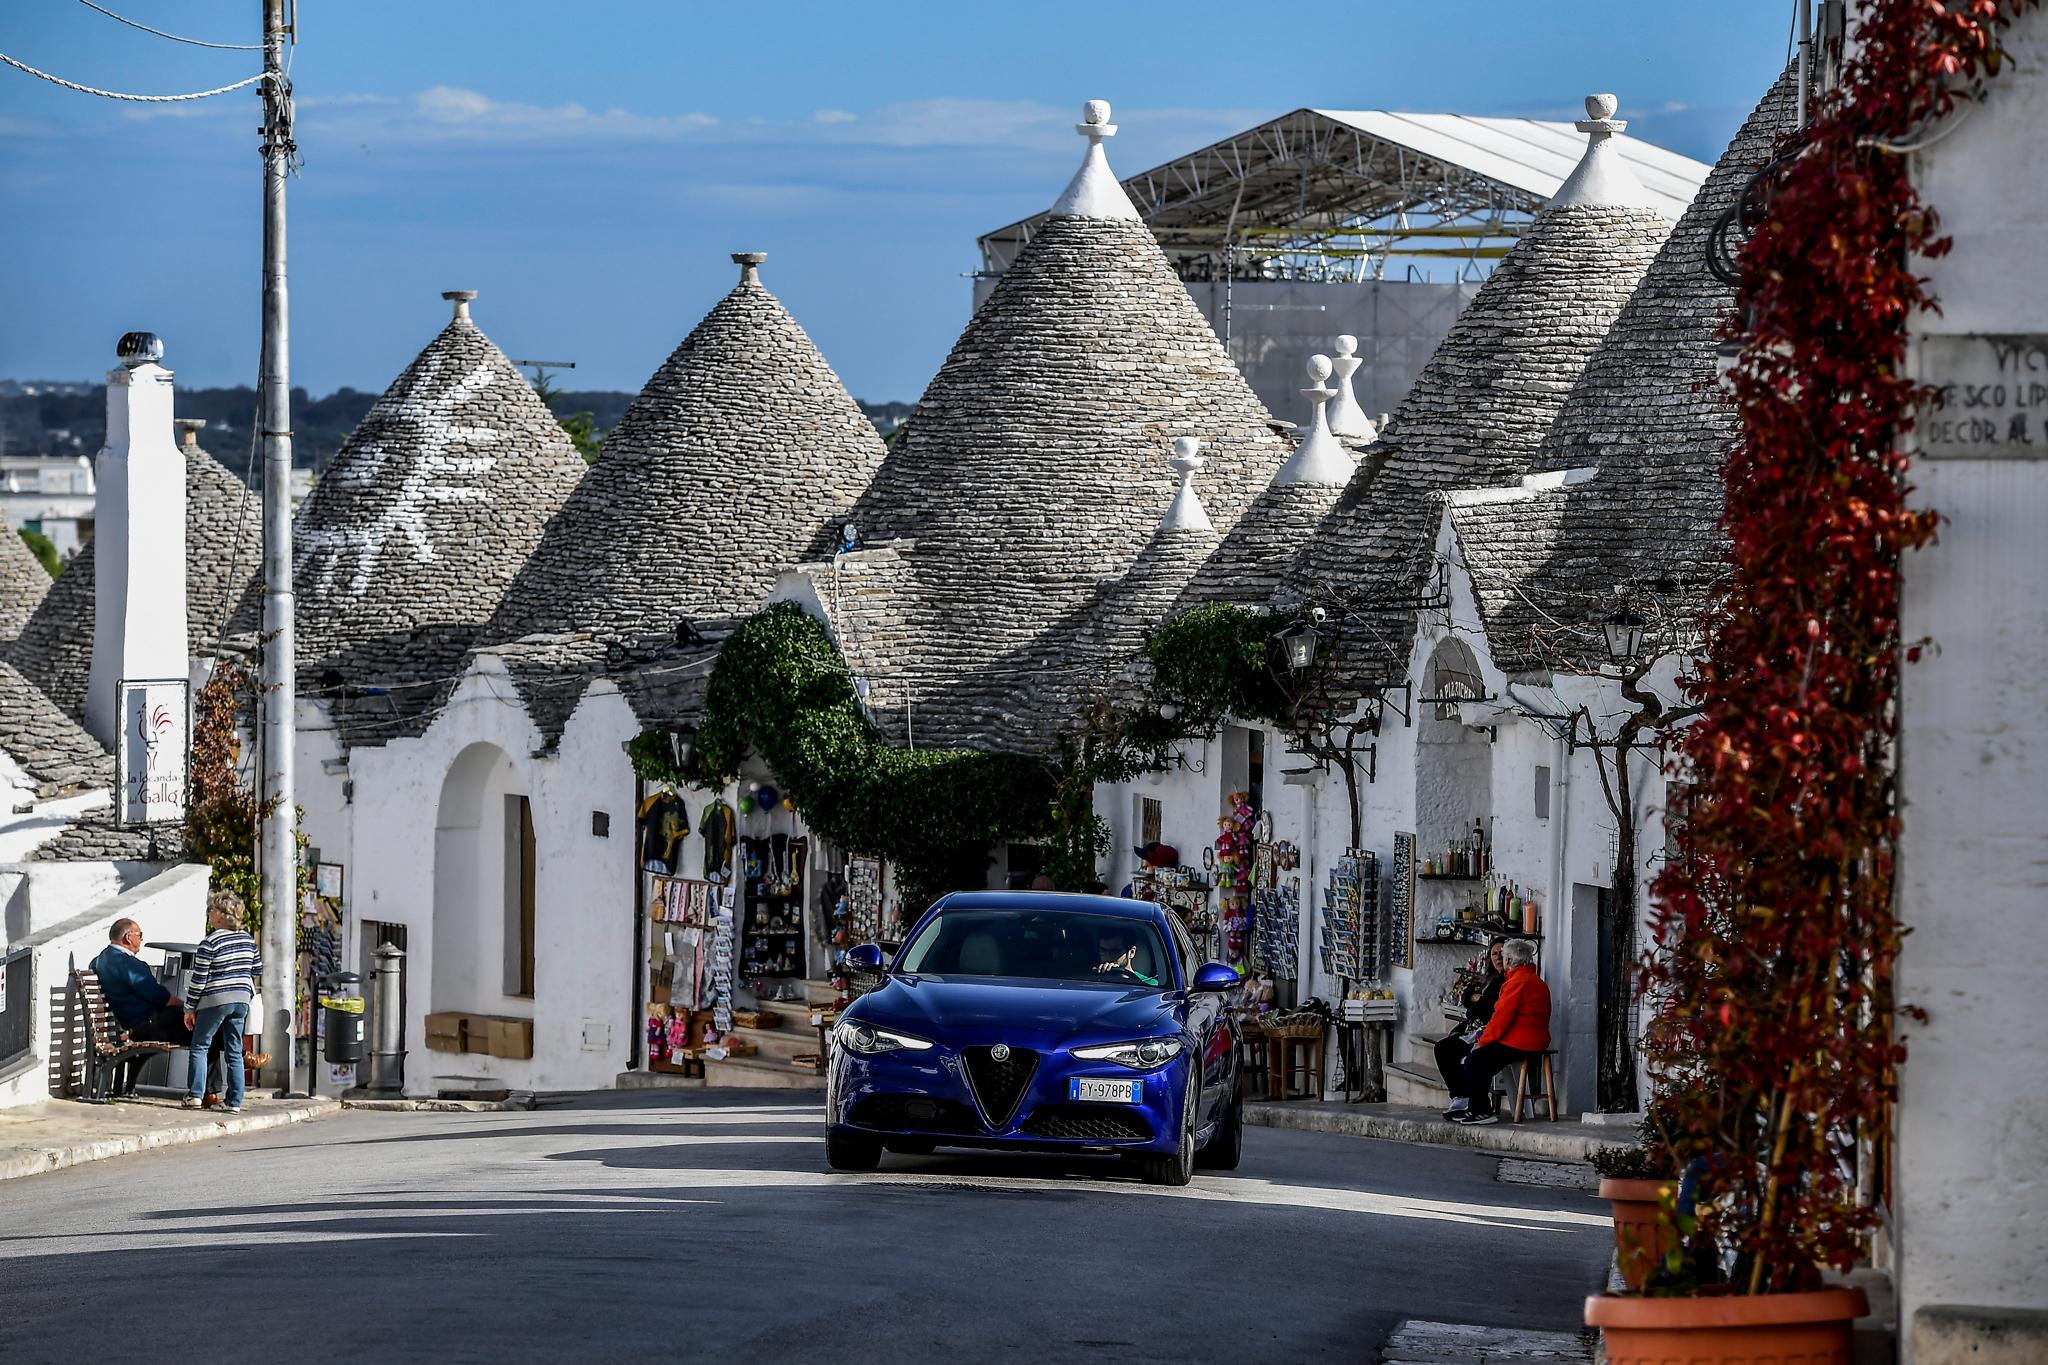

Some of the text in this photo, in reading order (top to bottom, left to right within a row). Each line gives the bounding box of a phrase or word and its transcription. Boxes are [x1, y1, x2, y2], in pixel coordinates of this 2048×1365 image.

[1994, 343, 2048, 371] VIC
[128, 771, 178, 783] la locanda
[140, 783, 177, 805] Gallo
